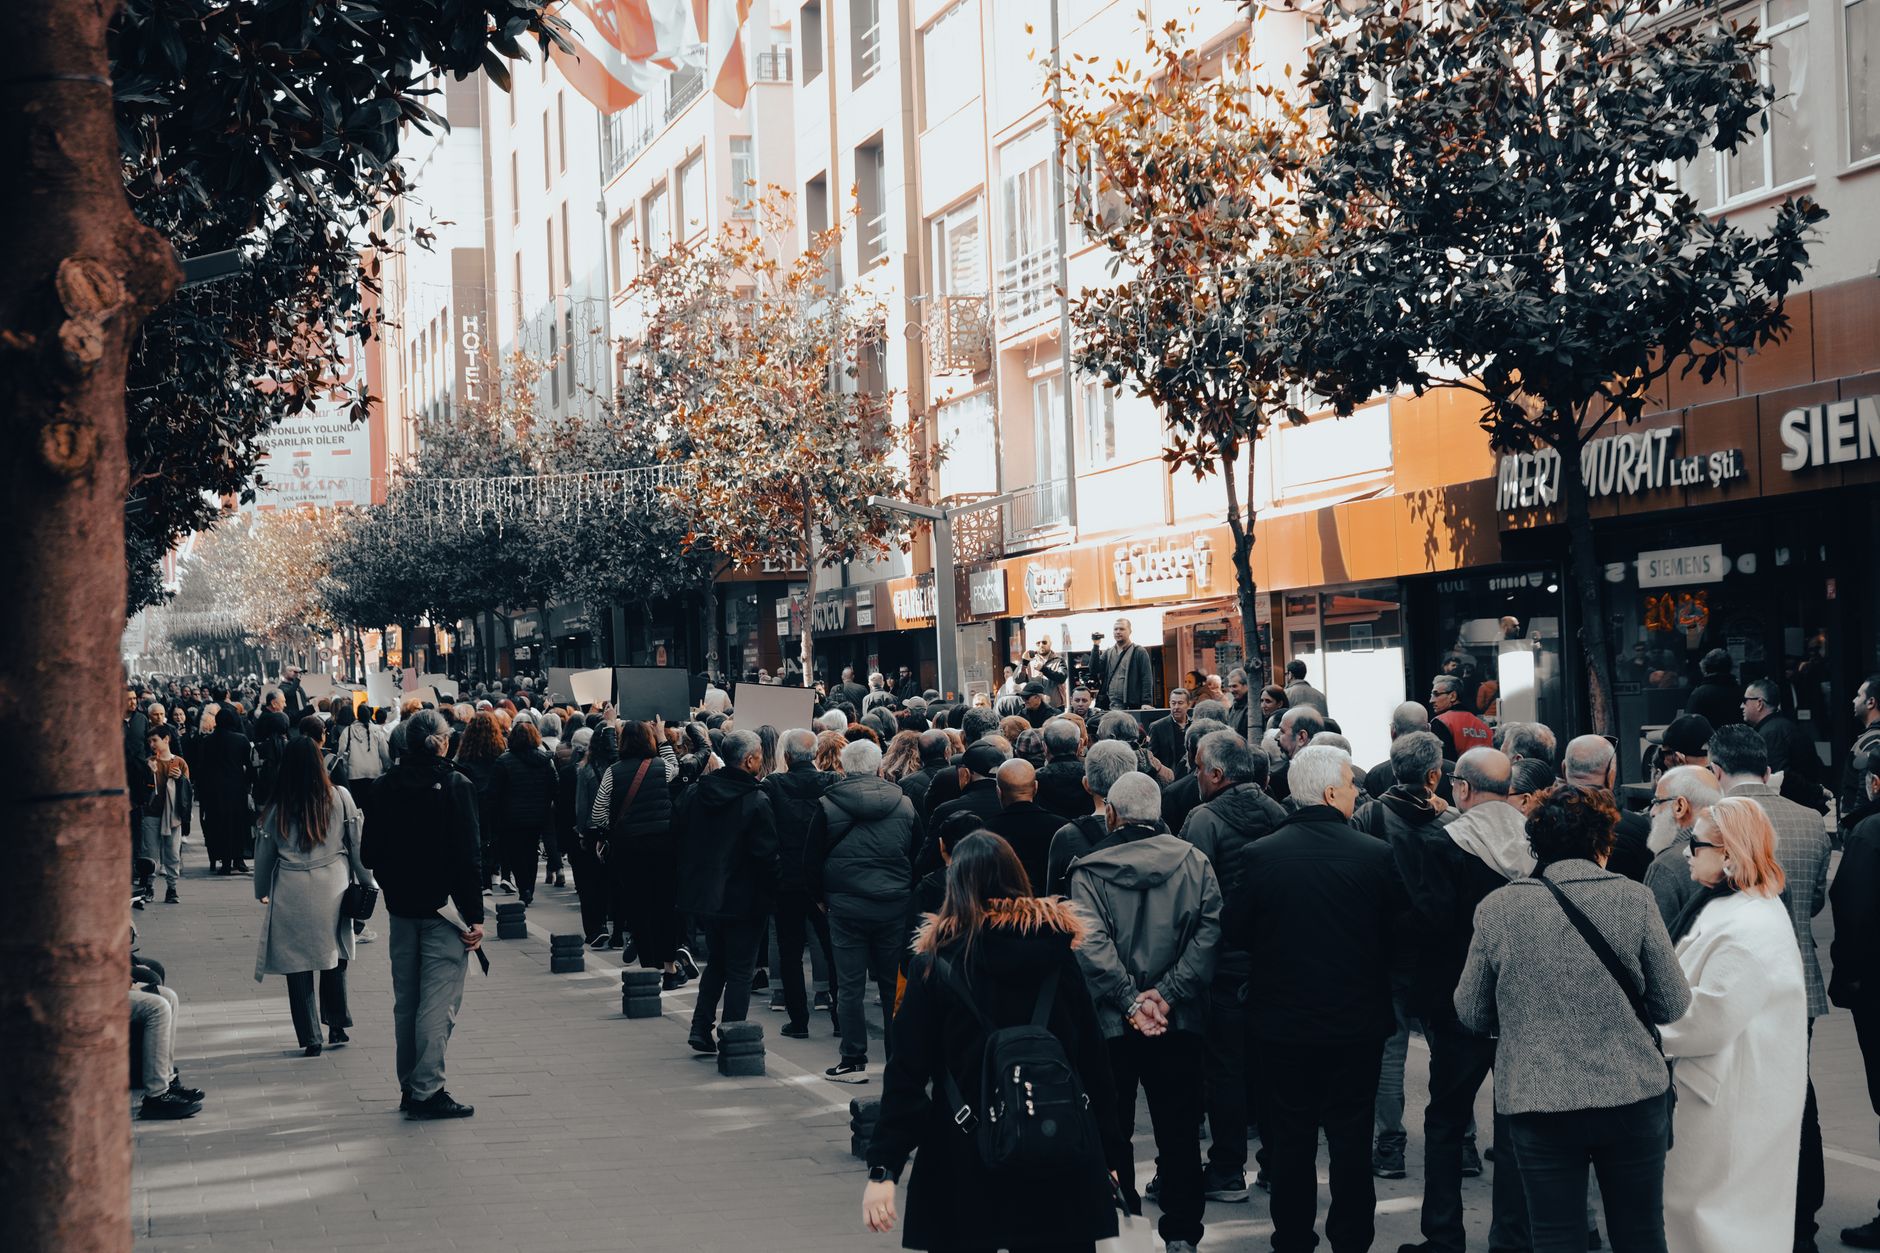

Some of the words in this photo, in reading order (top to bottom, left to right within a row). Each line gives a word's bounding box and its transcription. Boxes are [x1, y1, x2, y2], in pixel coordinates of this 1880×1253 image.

[462, 316, 480, 400] HOTEL
[314, 424, 360, 434] YOLUNDA
[257, 438, 313, 448] BAŞARILAR
[316, 436, 345, 445] DİLER
[1581, 427, 1673, 497] MURAT
[1670, 456, 1705, 486] Ltd.
[1709, 449, 1740, 488] Şti.
[1650, 555, 1710, 578] SIEMENS
